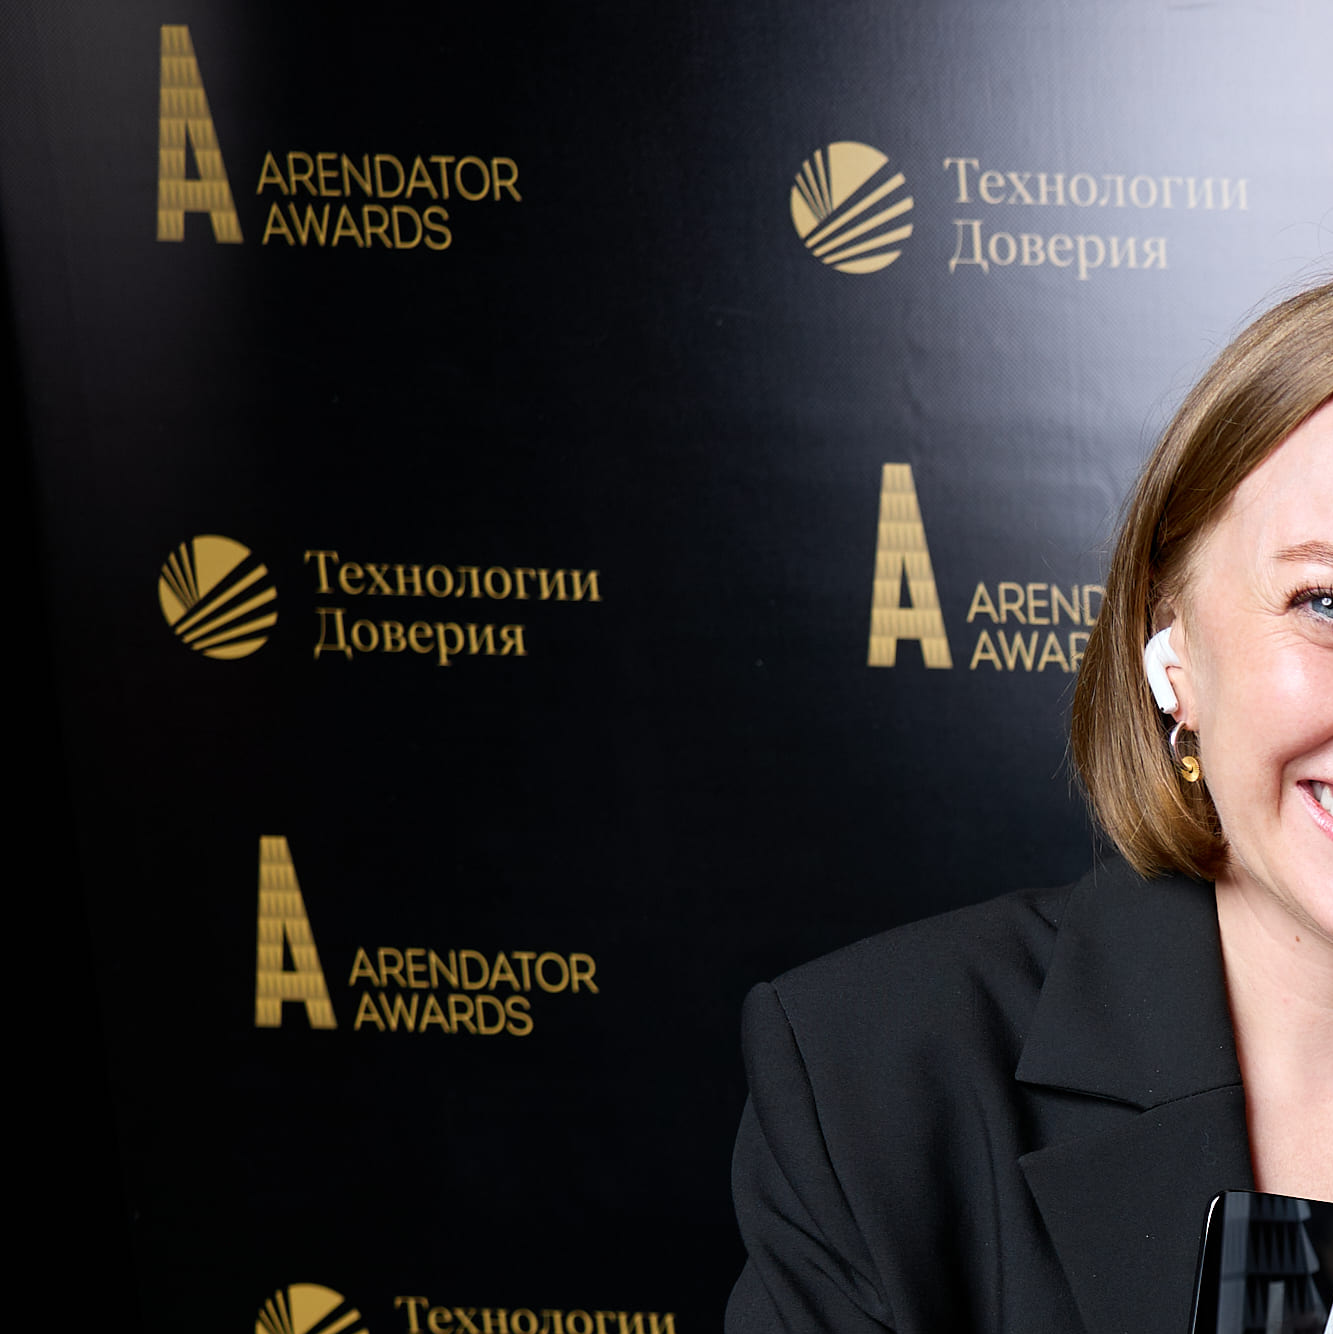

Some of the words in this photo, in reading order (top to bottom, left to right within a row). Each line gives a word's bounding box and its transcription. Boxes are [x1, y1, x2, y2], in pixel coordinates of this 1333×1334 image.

[256, 151, 522, 201] ARENDATOR
[943, 157, 1250, 210] Технологии
[262, 202, 453, 250] AWARDS
[948, 219, 1169, 280] Доверия
[304, 550, 603, 602] Технологии
[966, 581, 1107, 626] AREND
[314, 608, 528, 666] Доверия
[970, 629, 1090, 673] AWAR
[349, 947, 600, 993] ARENDATOR
[354, 992, 534, 1036] AWARDS
